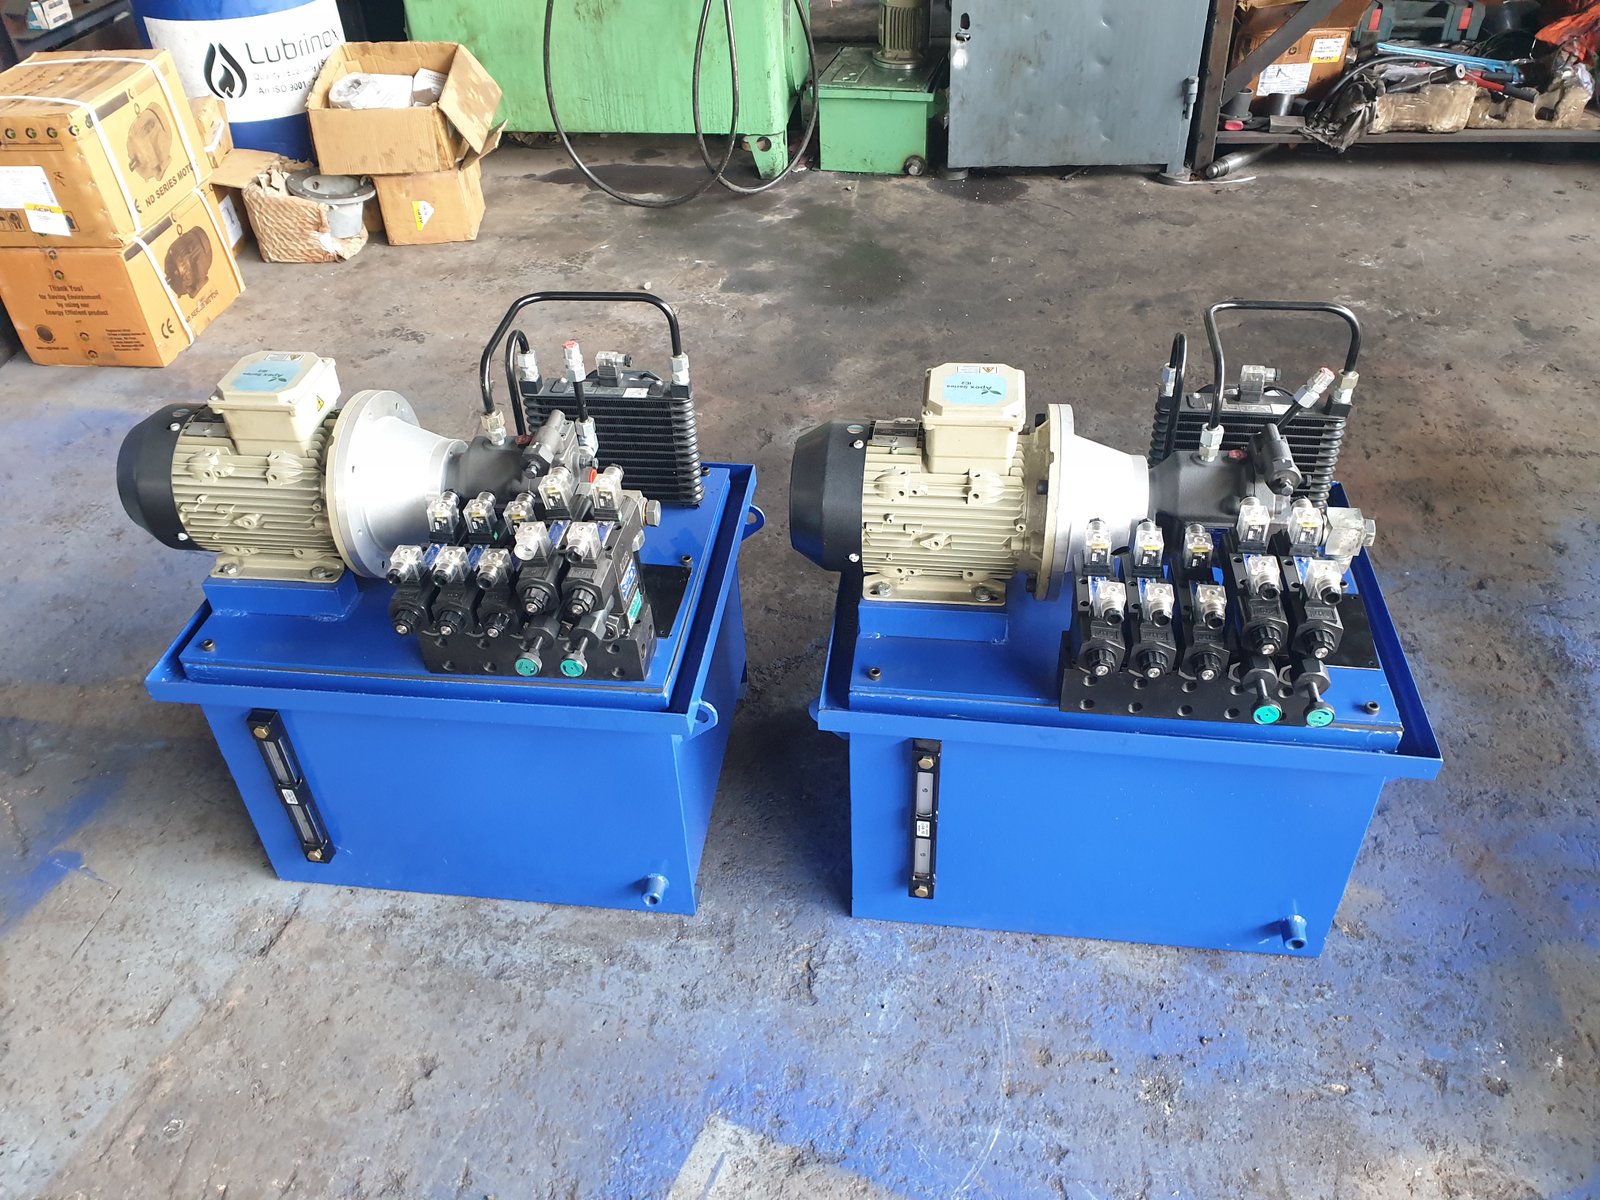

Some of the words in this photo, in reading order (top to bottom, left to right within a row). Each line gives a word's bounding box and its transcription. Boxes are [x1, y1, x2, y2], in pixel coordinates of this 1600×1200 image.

[272, 84, 287, 93] ISO
[145, 194, 156, 207] ND
[155, 176, 178, 199] SERIES
[177, 160, 198, 179] MOTO
[68, 284, 84, 292] You!
